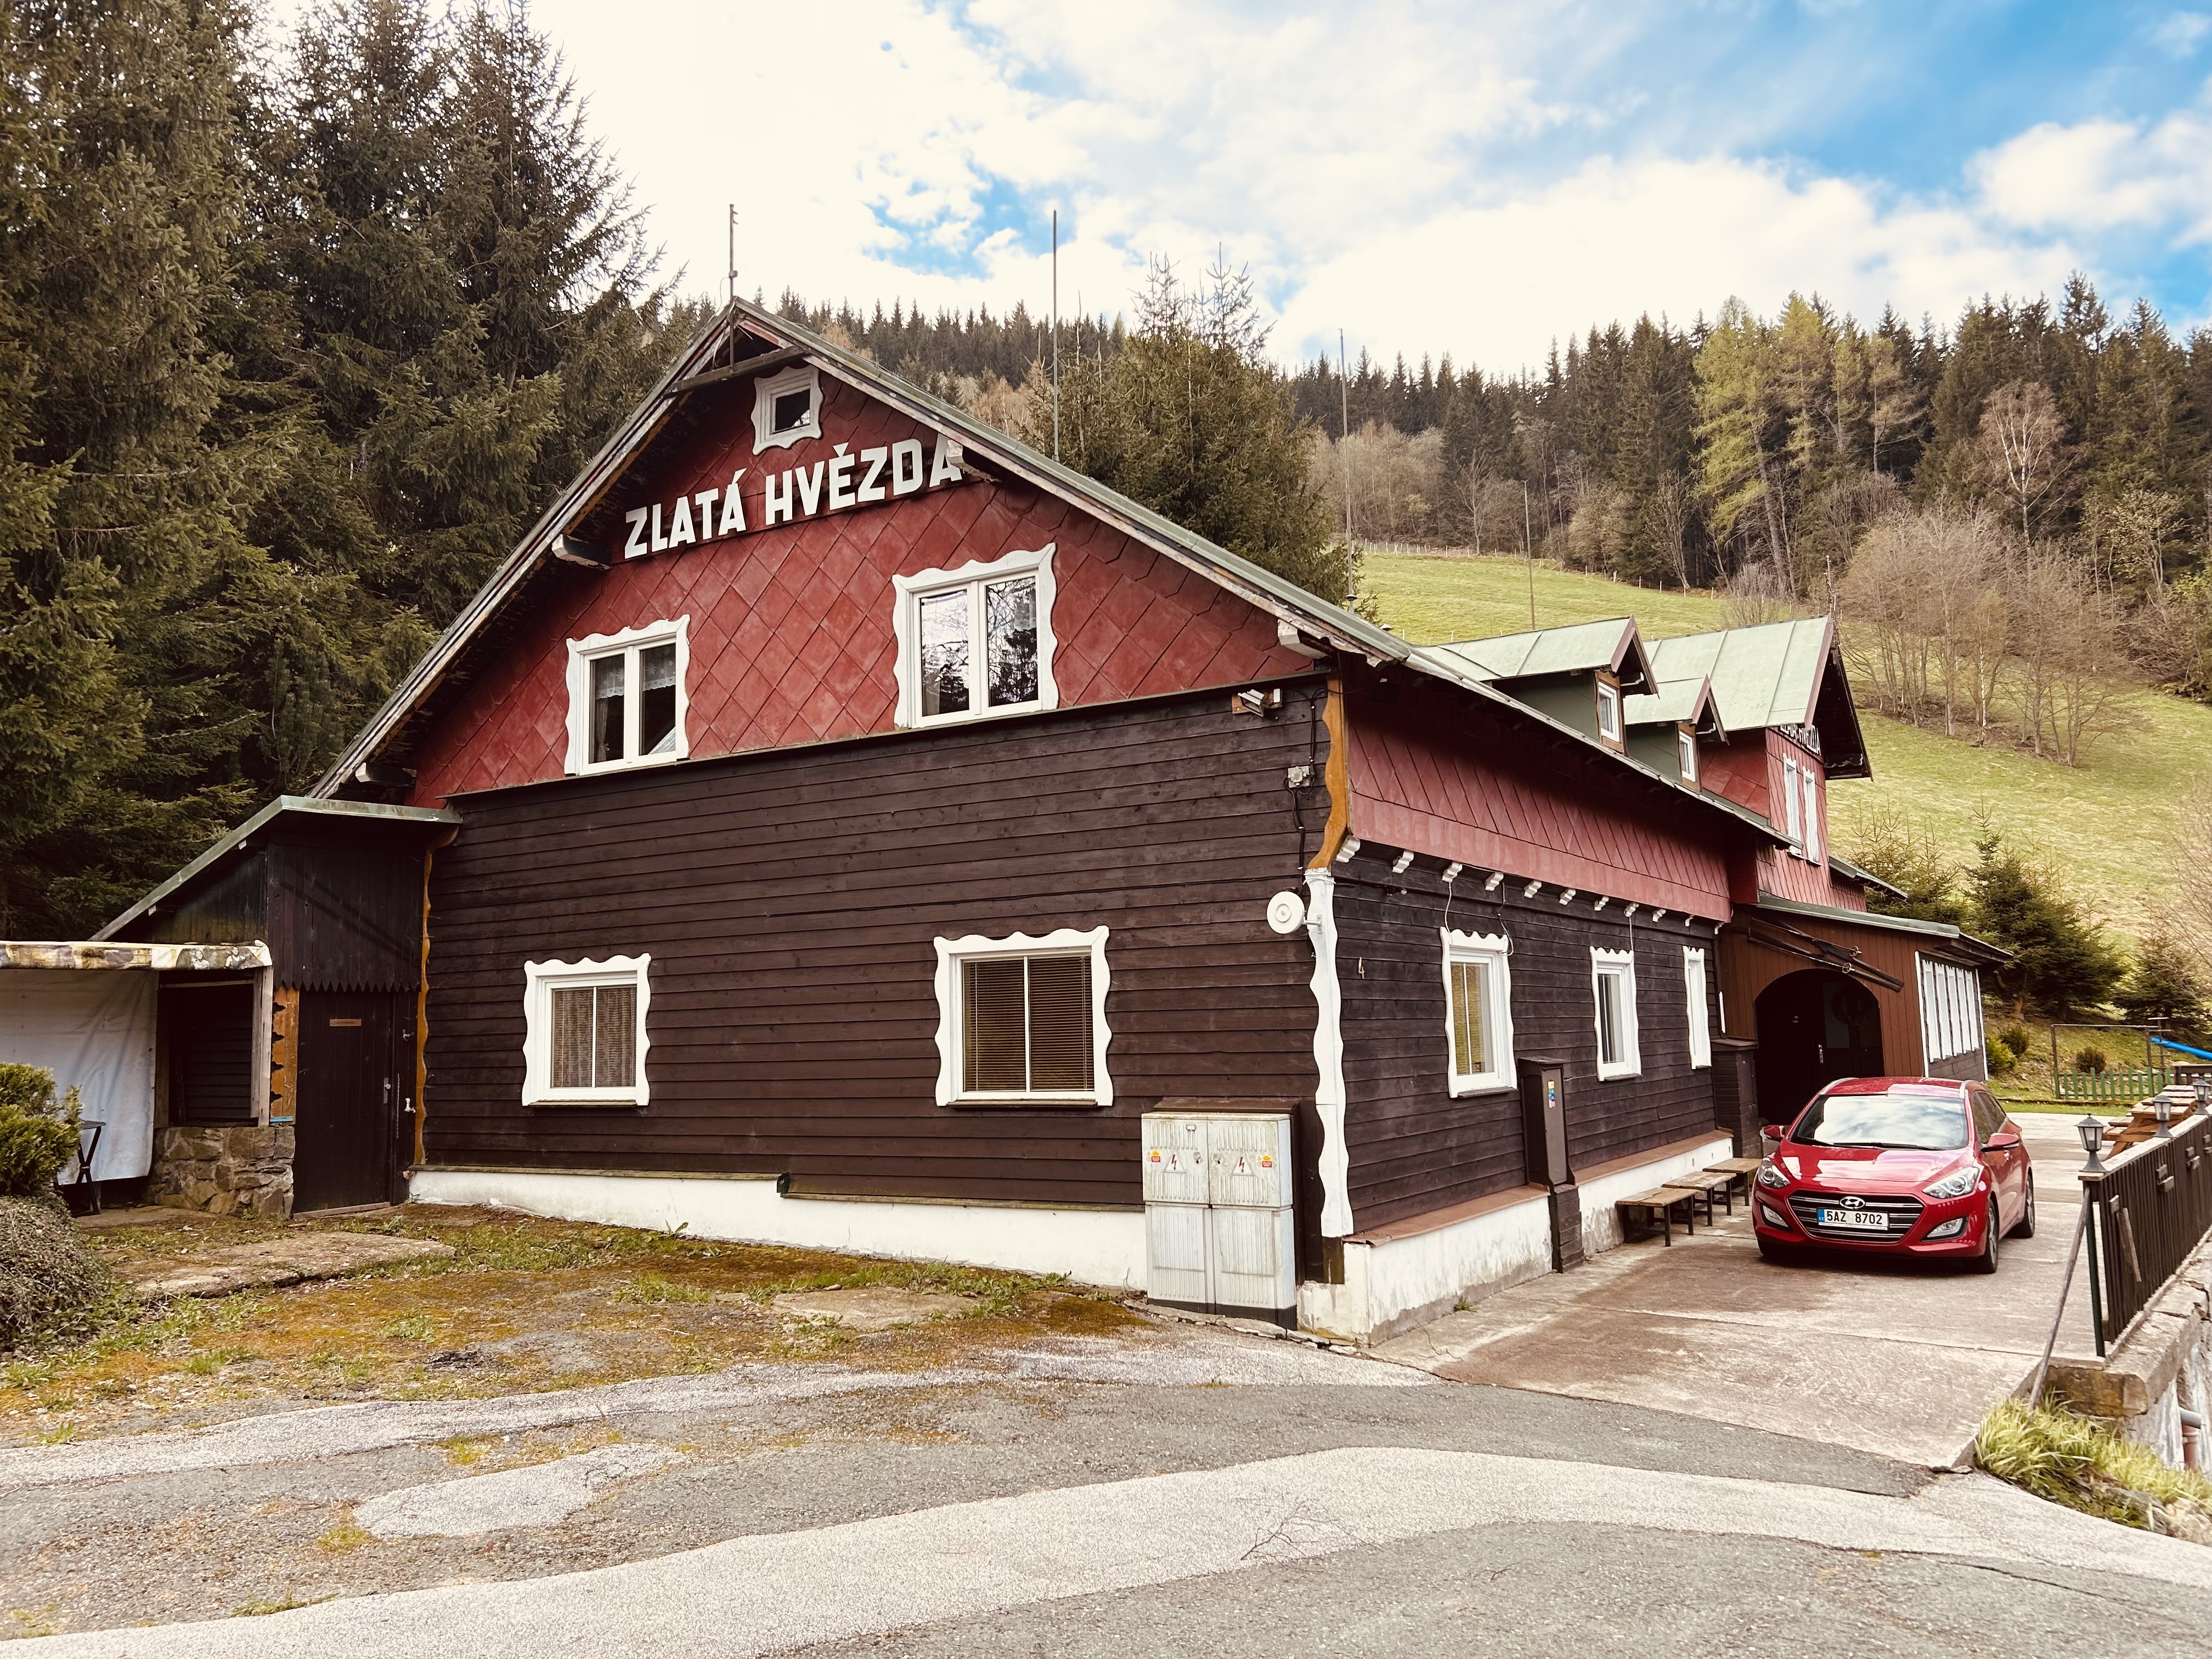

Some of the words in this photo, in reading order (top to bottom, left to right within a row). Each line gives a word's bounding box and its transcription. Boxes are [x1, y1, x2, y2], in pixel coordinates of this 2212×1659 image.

[624, 467, 747, 560] ZLATÁ
[765, 432, 963, 526] HVĚZDA
[1826, 1210, 1847, 1222] 5AZ
[1855, 1212, 1883, 1224] 8702
